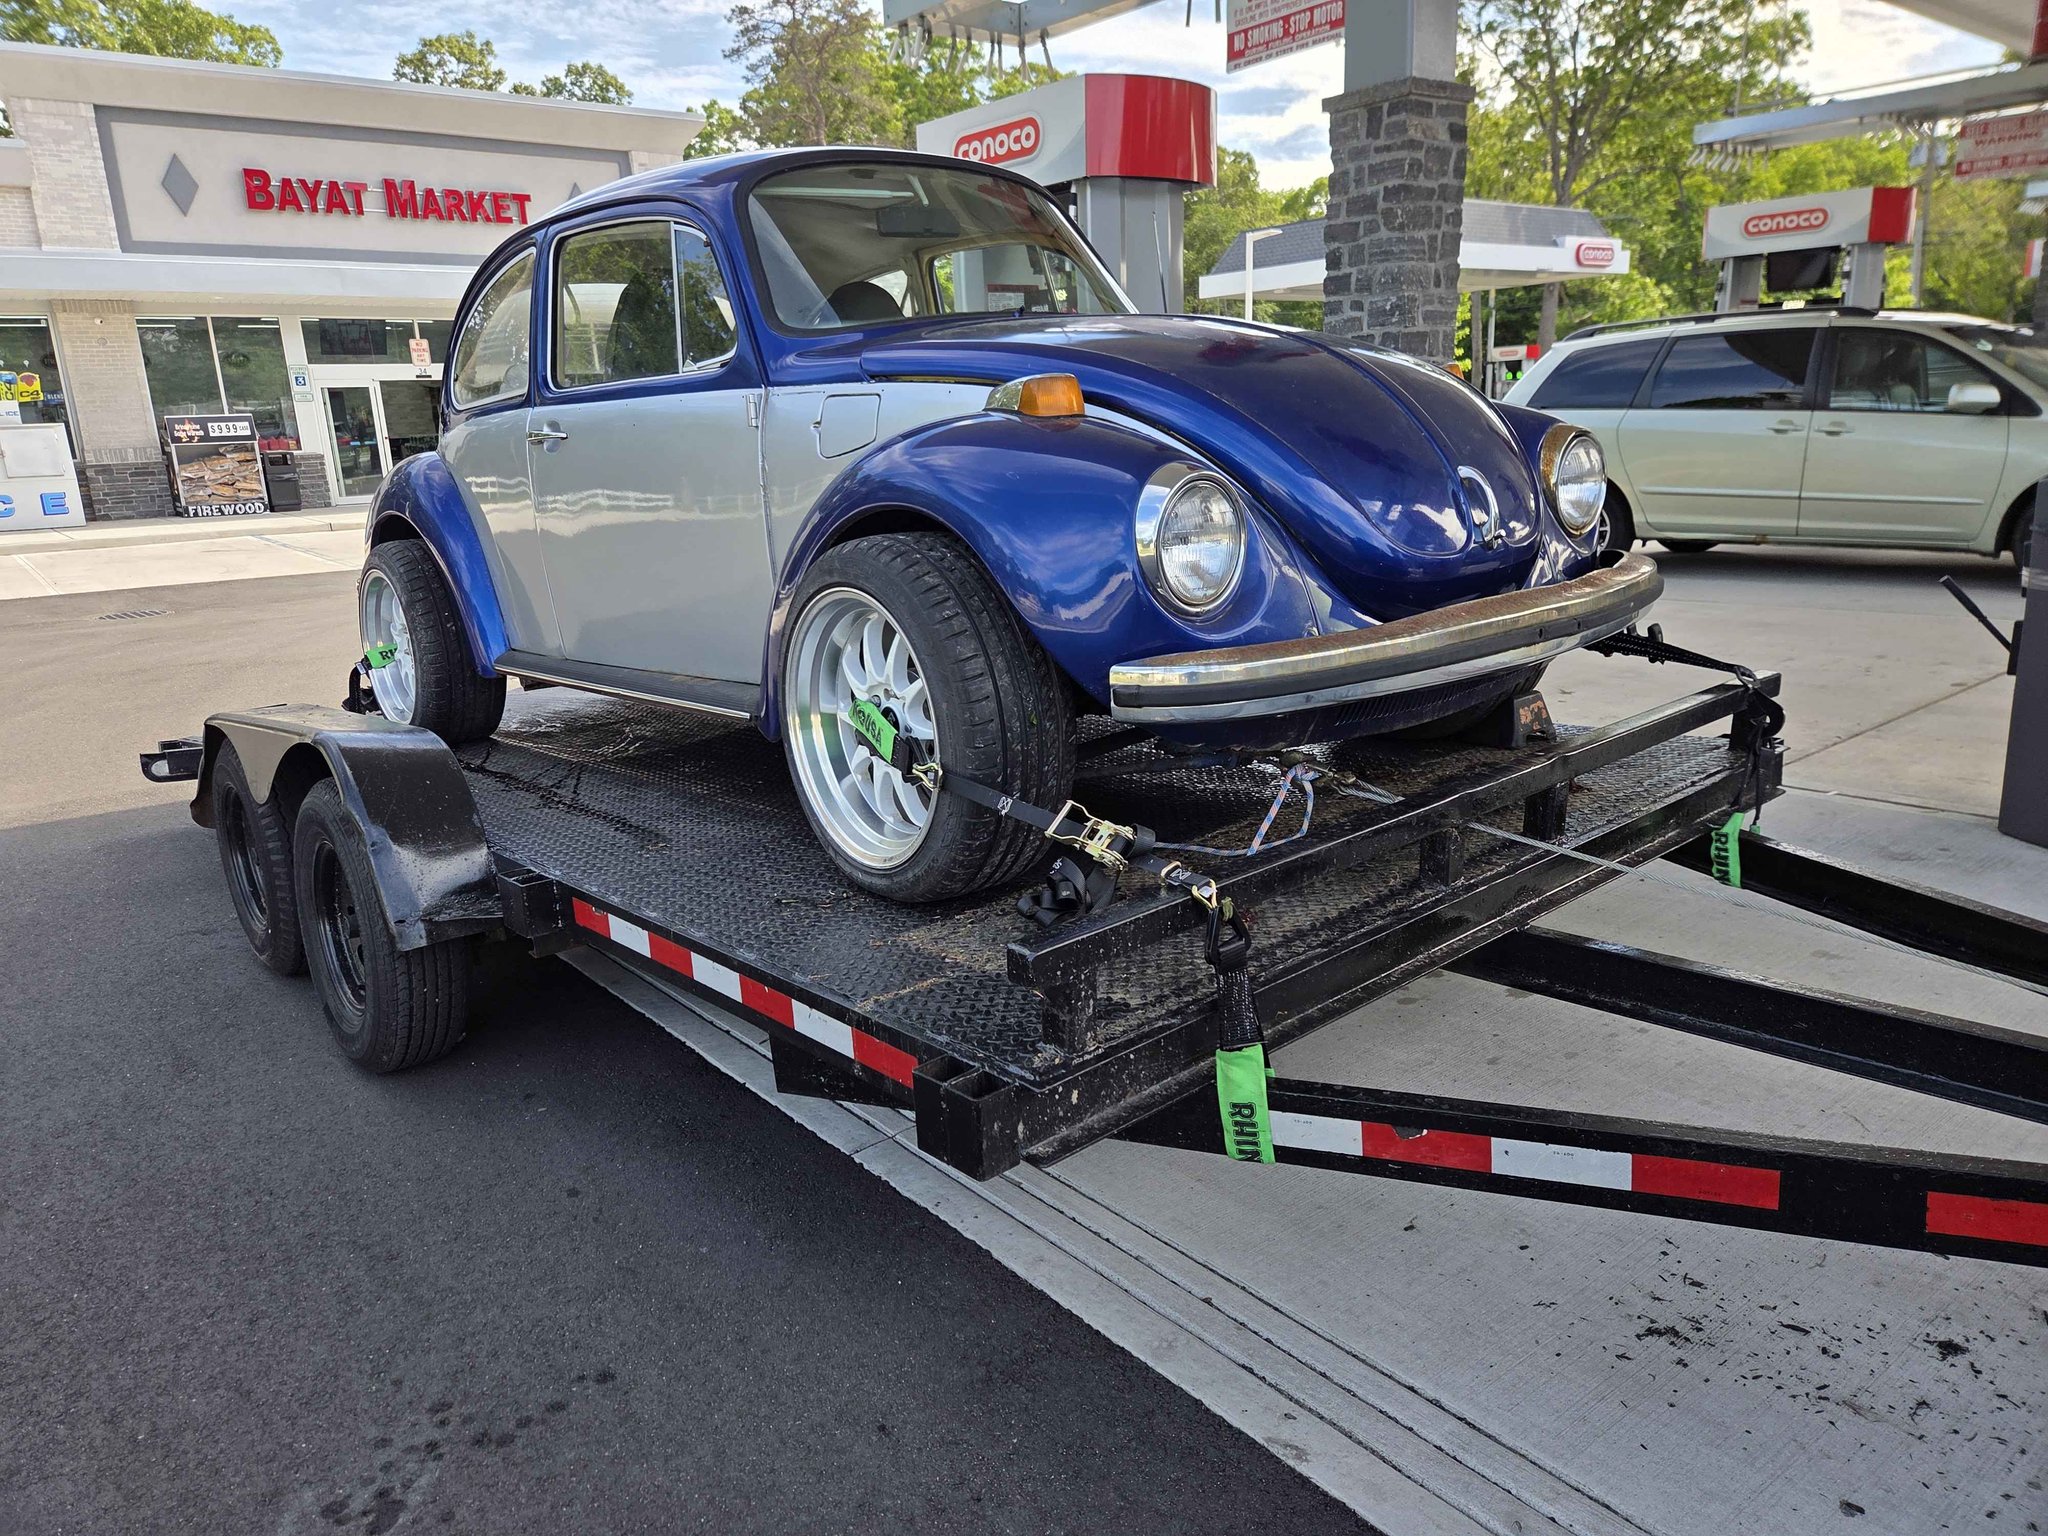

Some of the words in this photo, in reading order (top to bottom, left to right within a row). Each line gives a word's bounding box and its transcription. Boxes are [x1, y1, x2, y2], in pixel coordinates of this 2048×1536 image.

[1234, 32, 1245, 52] NO
[1247, 20, 1283, 48] SMOKING
[1289, 11, 1311, 34] STOP
[1313, 2, 1343, 26] MOTOR
[1275, 47, 1294, 57] STATE
[242, 167, 367, 217] BAYAT
[382, 178, 531, 226] MARKET
[20, 390, 41, 398] C4
[188, 503, 265, 517] FIREWOOD
